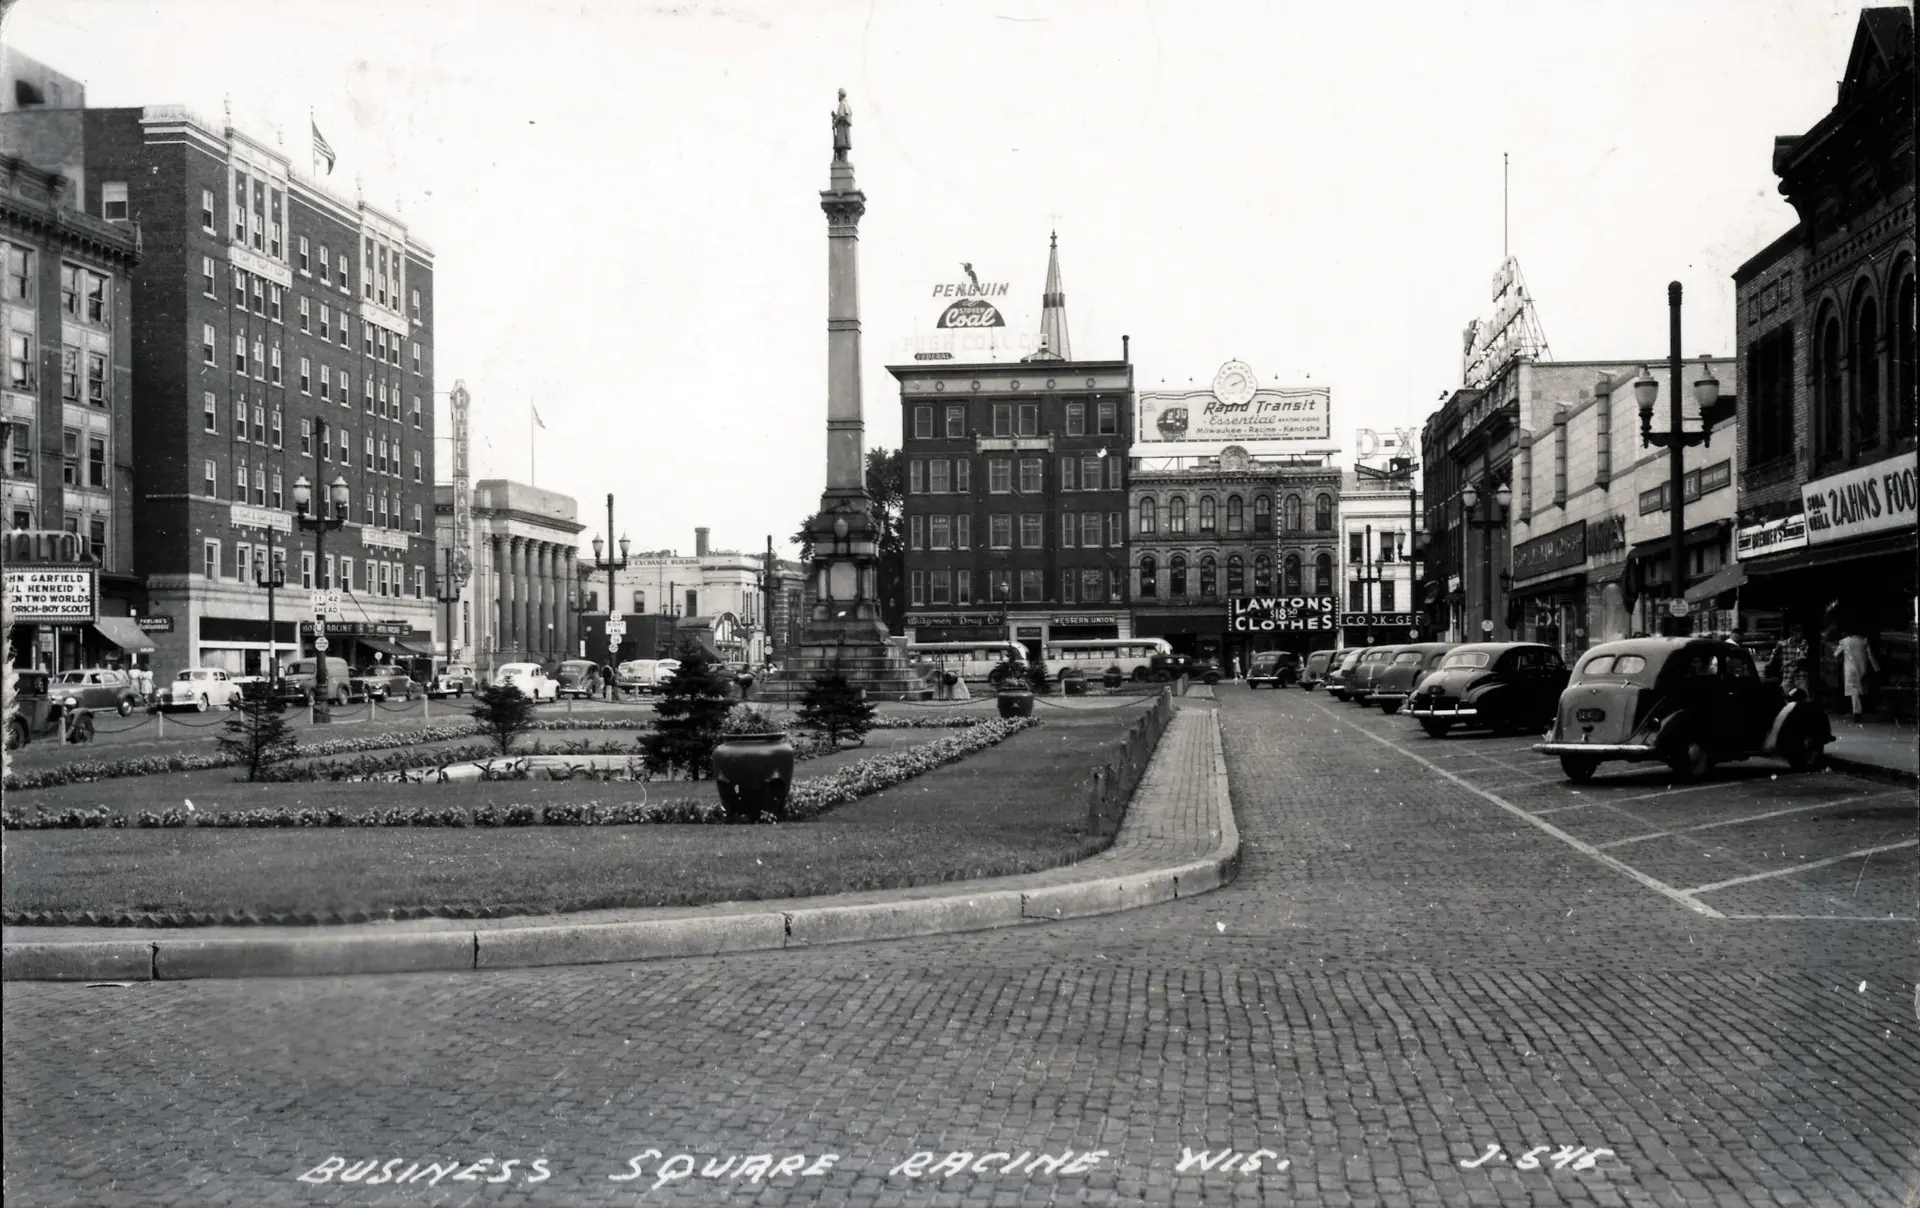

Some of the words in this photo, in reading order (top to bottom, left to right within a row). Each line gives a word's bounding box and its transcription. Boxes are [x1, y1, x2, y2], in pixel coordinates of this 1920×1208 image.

[932, 282, 1009, 298] PENGUIN
[945, 307, 997, 327] Coal
[1203, 401, 1249, 415] Rapid
[1256, 400, 1317, 414] Transit
[1209, 415, 1277, 426] Essential
[455, 391, 467, 472] HOTEL
[1196, 427, 1242, 435] Milwaukee
[1248, 426, 1277, 434] Racine
[1283, 425, 1321, 433] Kenosha
[1356, 427, 1417, 460] D-X
[1883, 467, 1917, 515] FOO
[8, 574, 24, 583] HN
[31, 574, 83, 583] GARFIELD
[28, 585, 74, 593] HENREID
[26, 594, 47, 603] TWO
[50, 594, 90, 603] WORLDS
[12, 605, 59, 613] DRICH-BOY
[61, 605, 90, 613] SCOUT
[1235, 597, 1333, 614] LAWTONS
[907, 616, 951, 627] Walgreen
[959, 616, 983, 627] Drug
[1054, 616, 1089, 624] WESTERN
[1091, 616, 1115, 624] UNION
[1235, 615, 1333, 630] CLOTHES
[326, 624, 353, 633] RACINE
